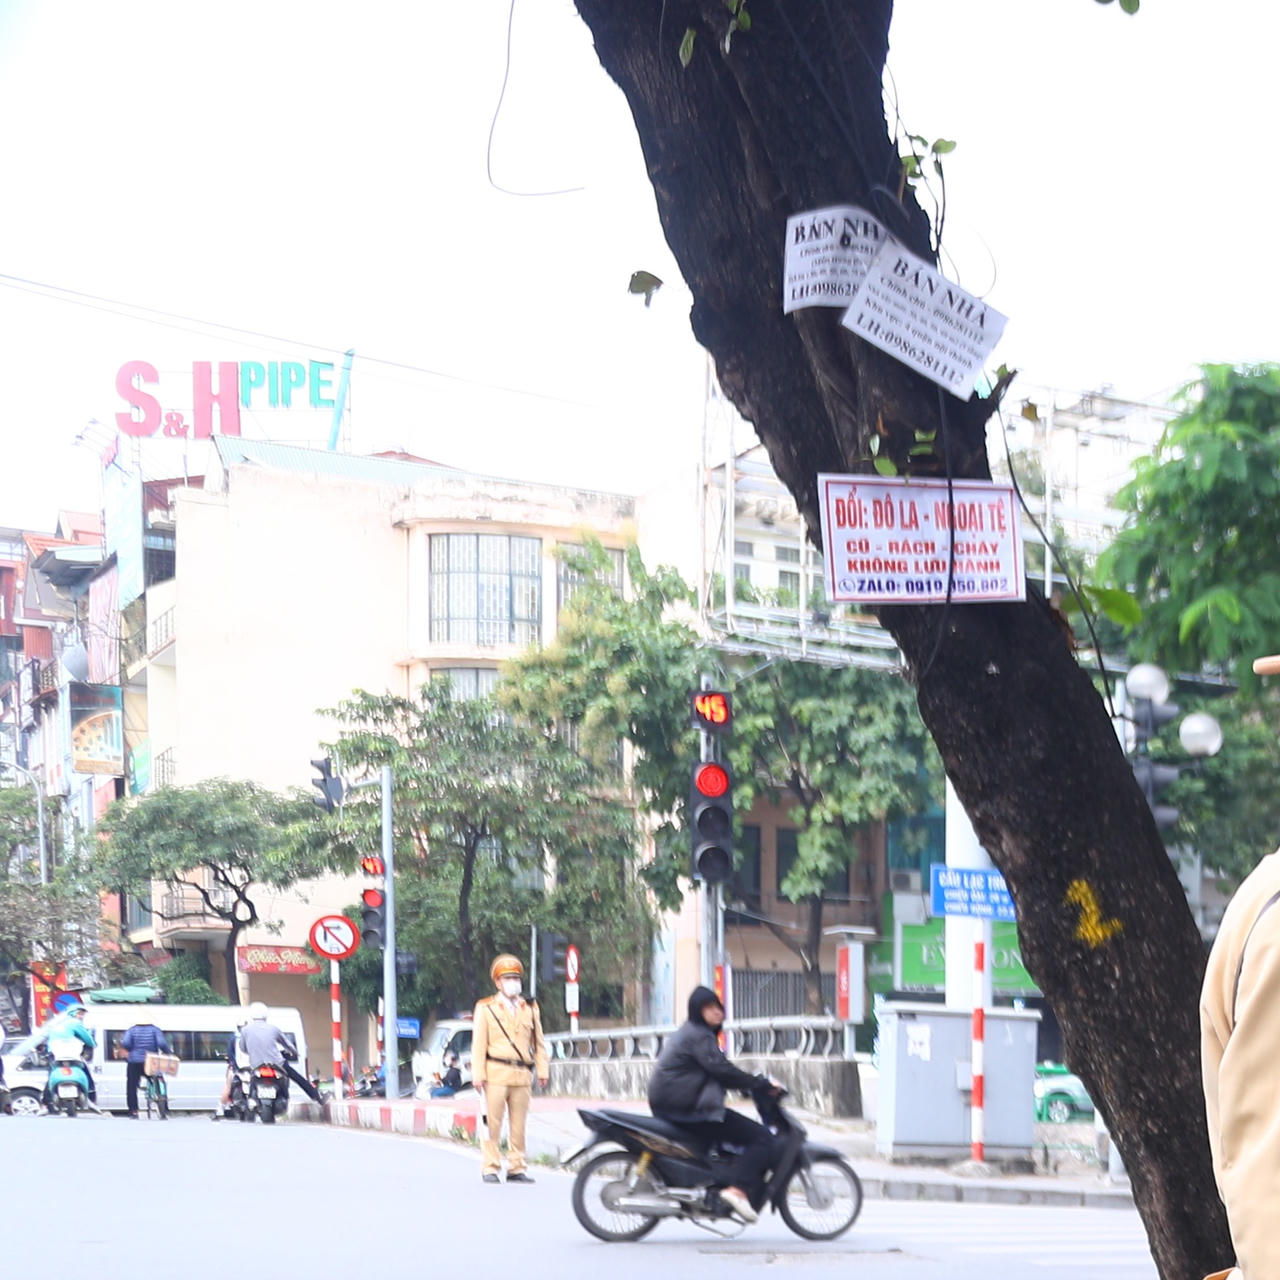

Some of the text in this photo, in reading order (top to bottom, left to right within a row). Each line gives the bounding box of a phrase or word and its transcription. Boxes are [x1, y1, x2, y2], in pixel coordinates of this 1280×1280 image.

[893, 256, 938, 297] BÁN
[941, 287, 988, 329] NHÀ
[240, 359, 335, 408] PIPE
[873, 492, 895, 531] ĐÔ
[900, 500, 919, 531] LA
[987, 497, 1007, 540] TỆ
[847, 557, 908, 575] KHÔNG
[694, 695, 728, 724] 45
